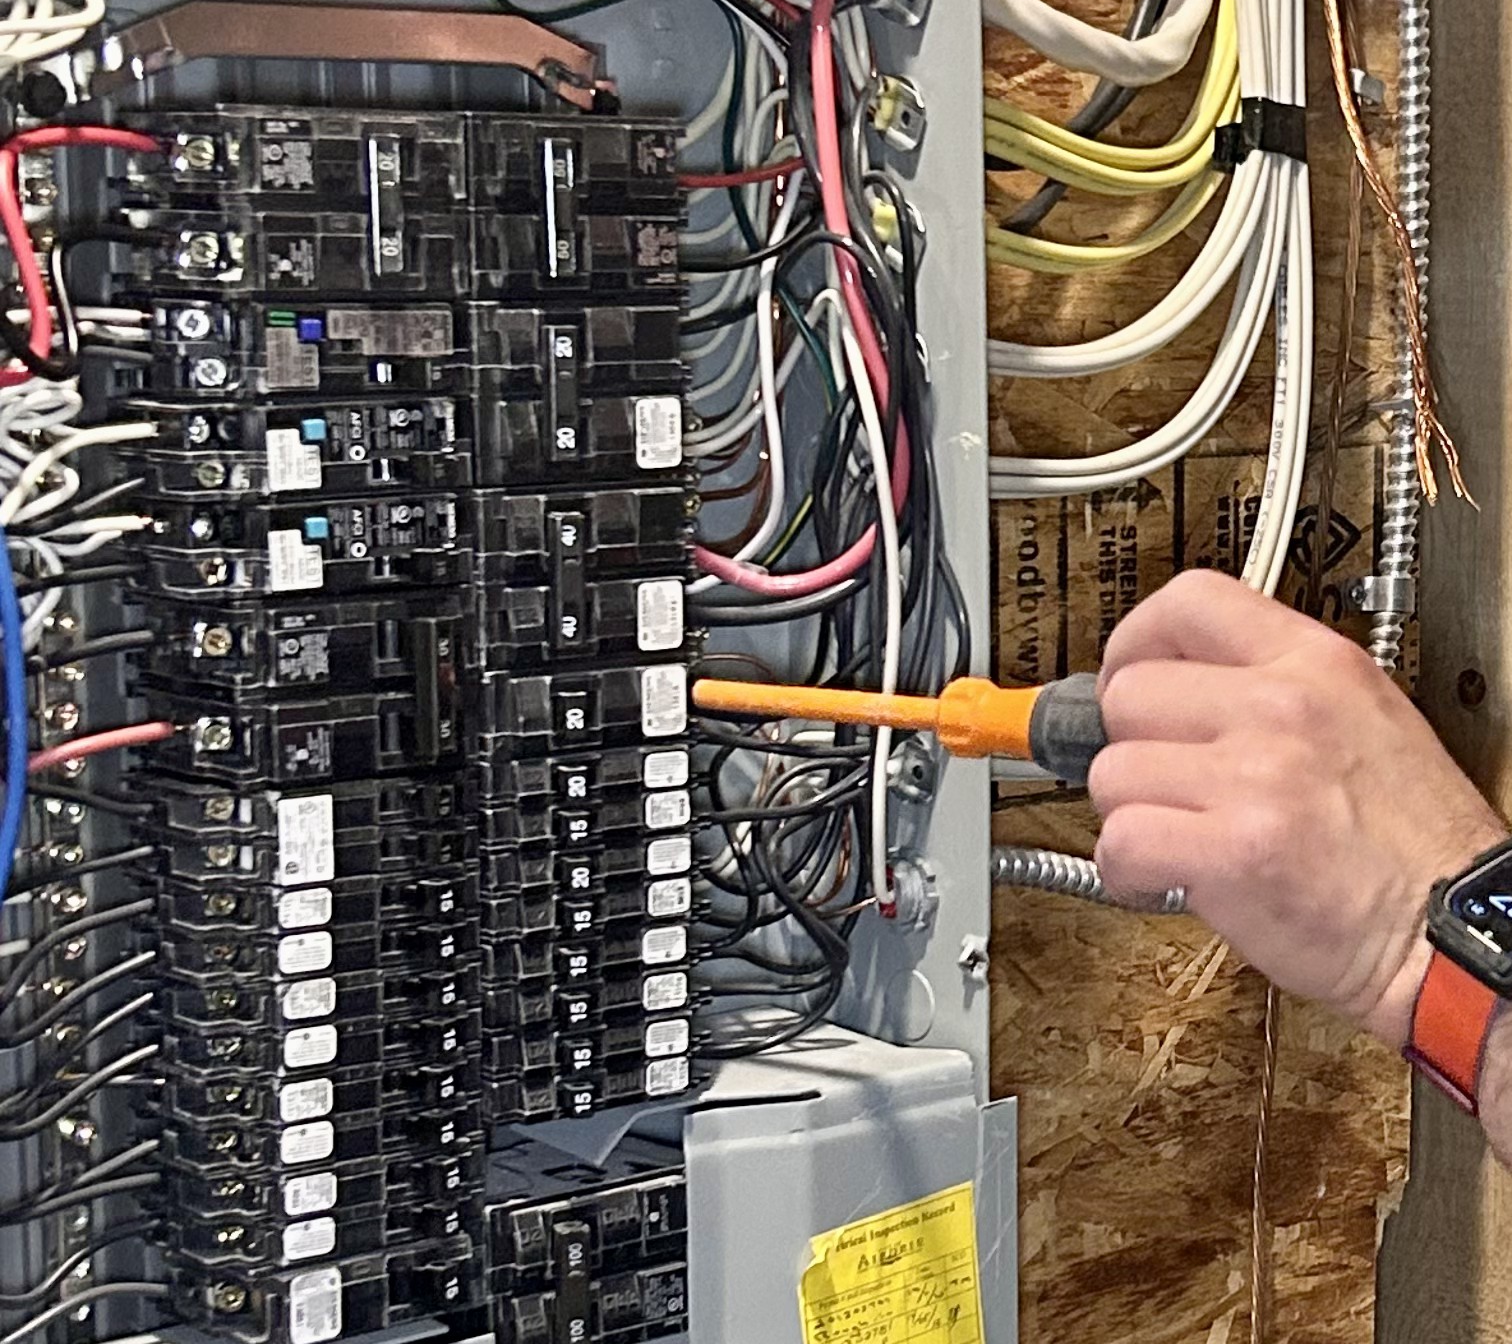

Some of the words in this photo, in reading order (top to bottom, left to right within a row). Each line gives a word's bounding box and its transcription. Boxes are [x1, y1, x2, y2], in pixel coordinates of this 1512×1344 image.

[380, 236, 400, 256] 20
[555, 336, 573, 358] 20
[557, 427, 576, 449] 20
[1272, 419, 1284, 460] 300V
[1265, 469, 1278, 499] CSA
[561, 524, 577, 546] 40
[1099, 526, 1116, 584] THIS
[561, 616, 577, 637] 40
[566, 708, 584, 730] 20
[568, 775, 586, 797] 20
[570, 819, 588, 840] 15
[572, 867, 589, 888] 20
[440, 890, 454, 912] 15
[574, 910, 592, 932] 15
[440, 934, 455, 957] 15
[570, 955, 588, 976] 15
[442, 982, 456, 1004] 15
[570, 1001, 588, 1022] 15
[443, 1029, 456, 1050] 15
[574, 1048, 592, 1069] 15
[440, 1075, 454, 1097] 15
[575, 1091, 592, 1113] 15
[440, 1122, 455, 1143] 15
[446, 1167, 460, 1188] 15
[445, 1211, 458, 1233] 15
[869, 1213, 919, 1242] Inspection
[920, 1200, 956, 1222] Record
[568, 1242, 583, 1267] 100
[445, 1277, 459, 1299] 15
[570, 1319, 584, 1343] 100
